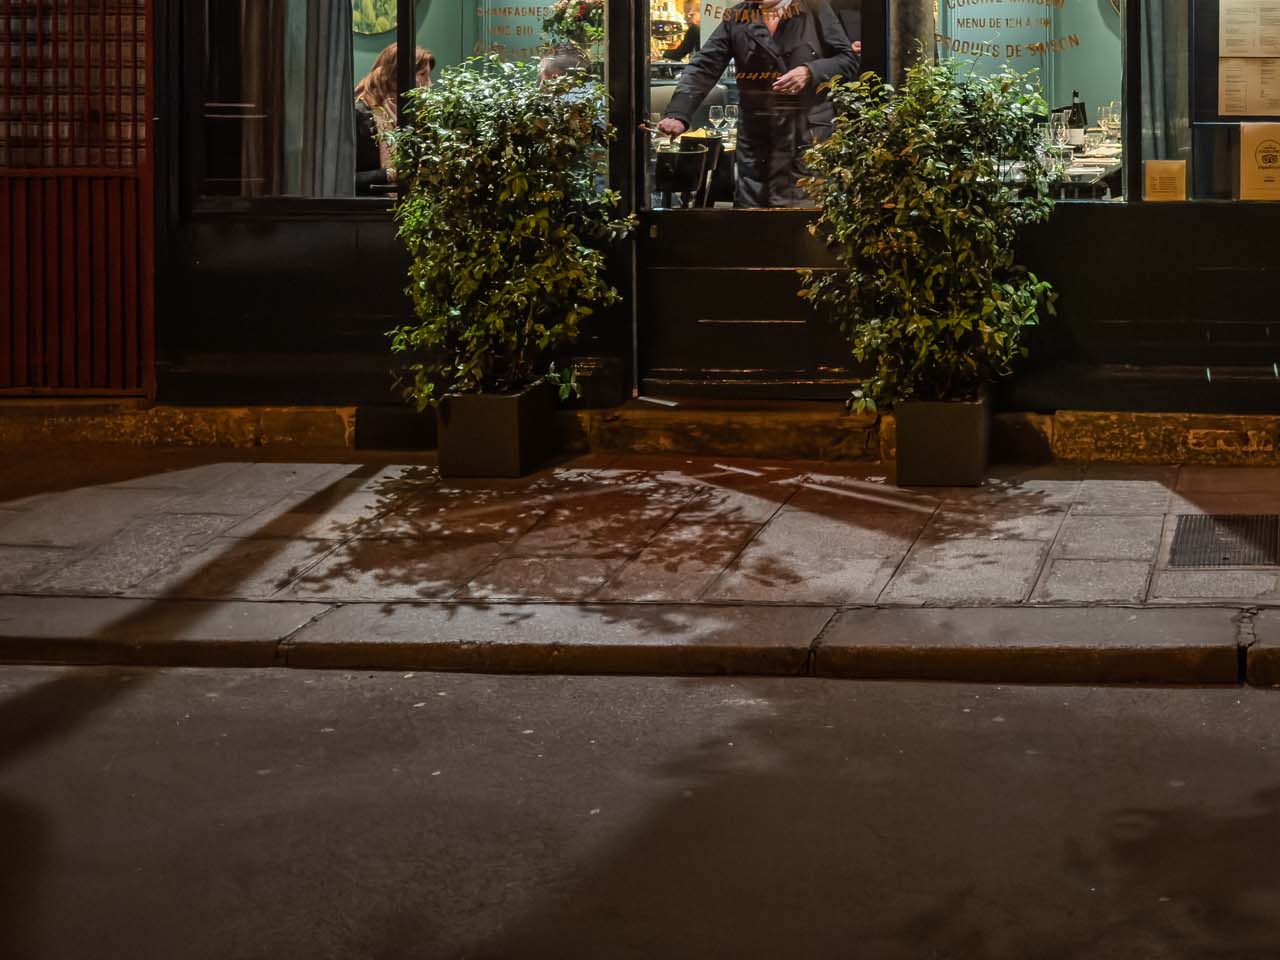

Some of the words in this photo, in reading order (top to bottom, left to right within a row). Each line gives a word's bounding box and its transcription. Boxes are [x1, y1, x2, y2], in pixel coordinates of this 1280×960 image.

[703, 3, 801, 25] RESTAURANT
[956, 18, 986, 29] MENU
[989, 18, 1004, 29] DE
[934, 33, 1000, 58] PRODUITS
[1005, 44, 1022, 58] DE
